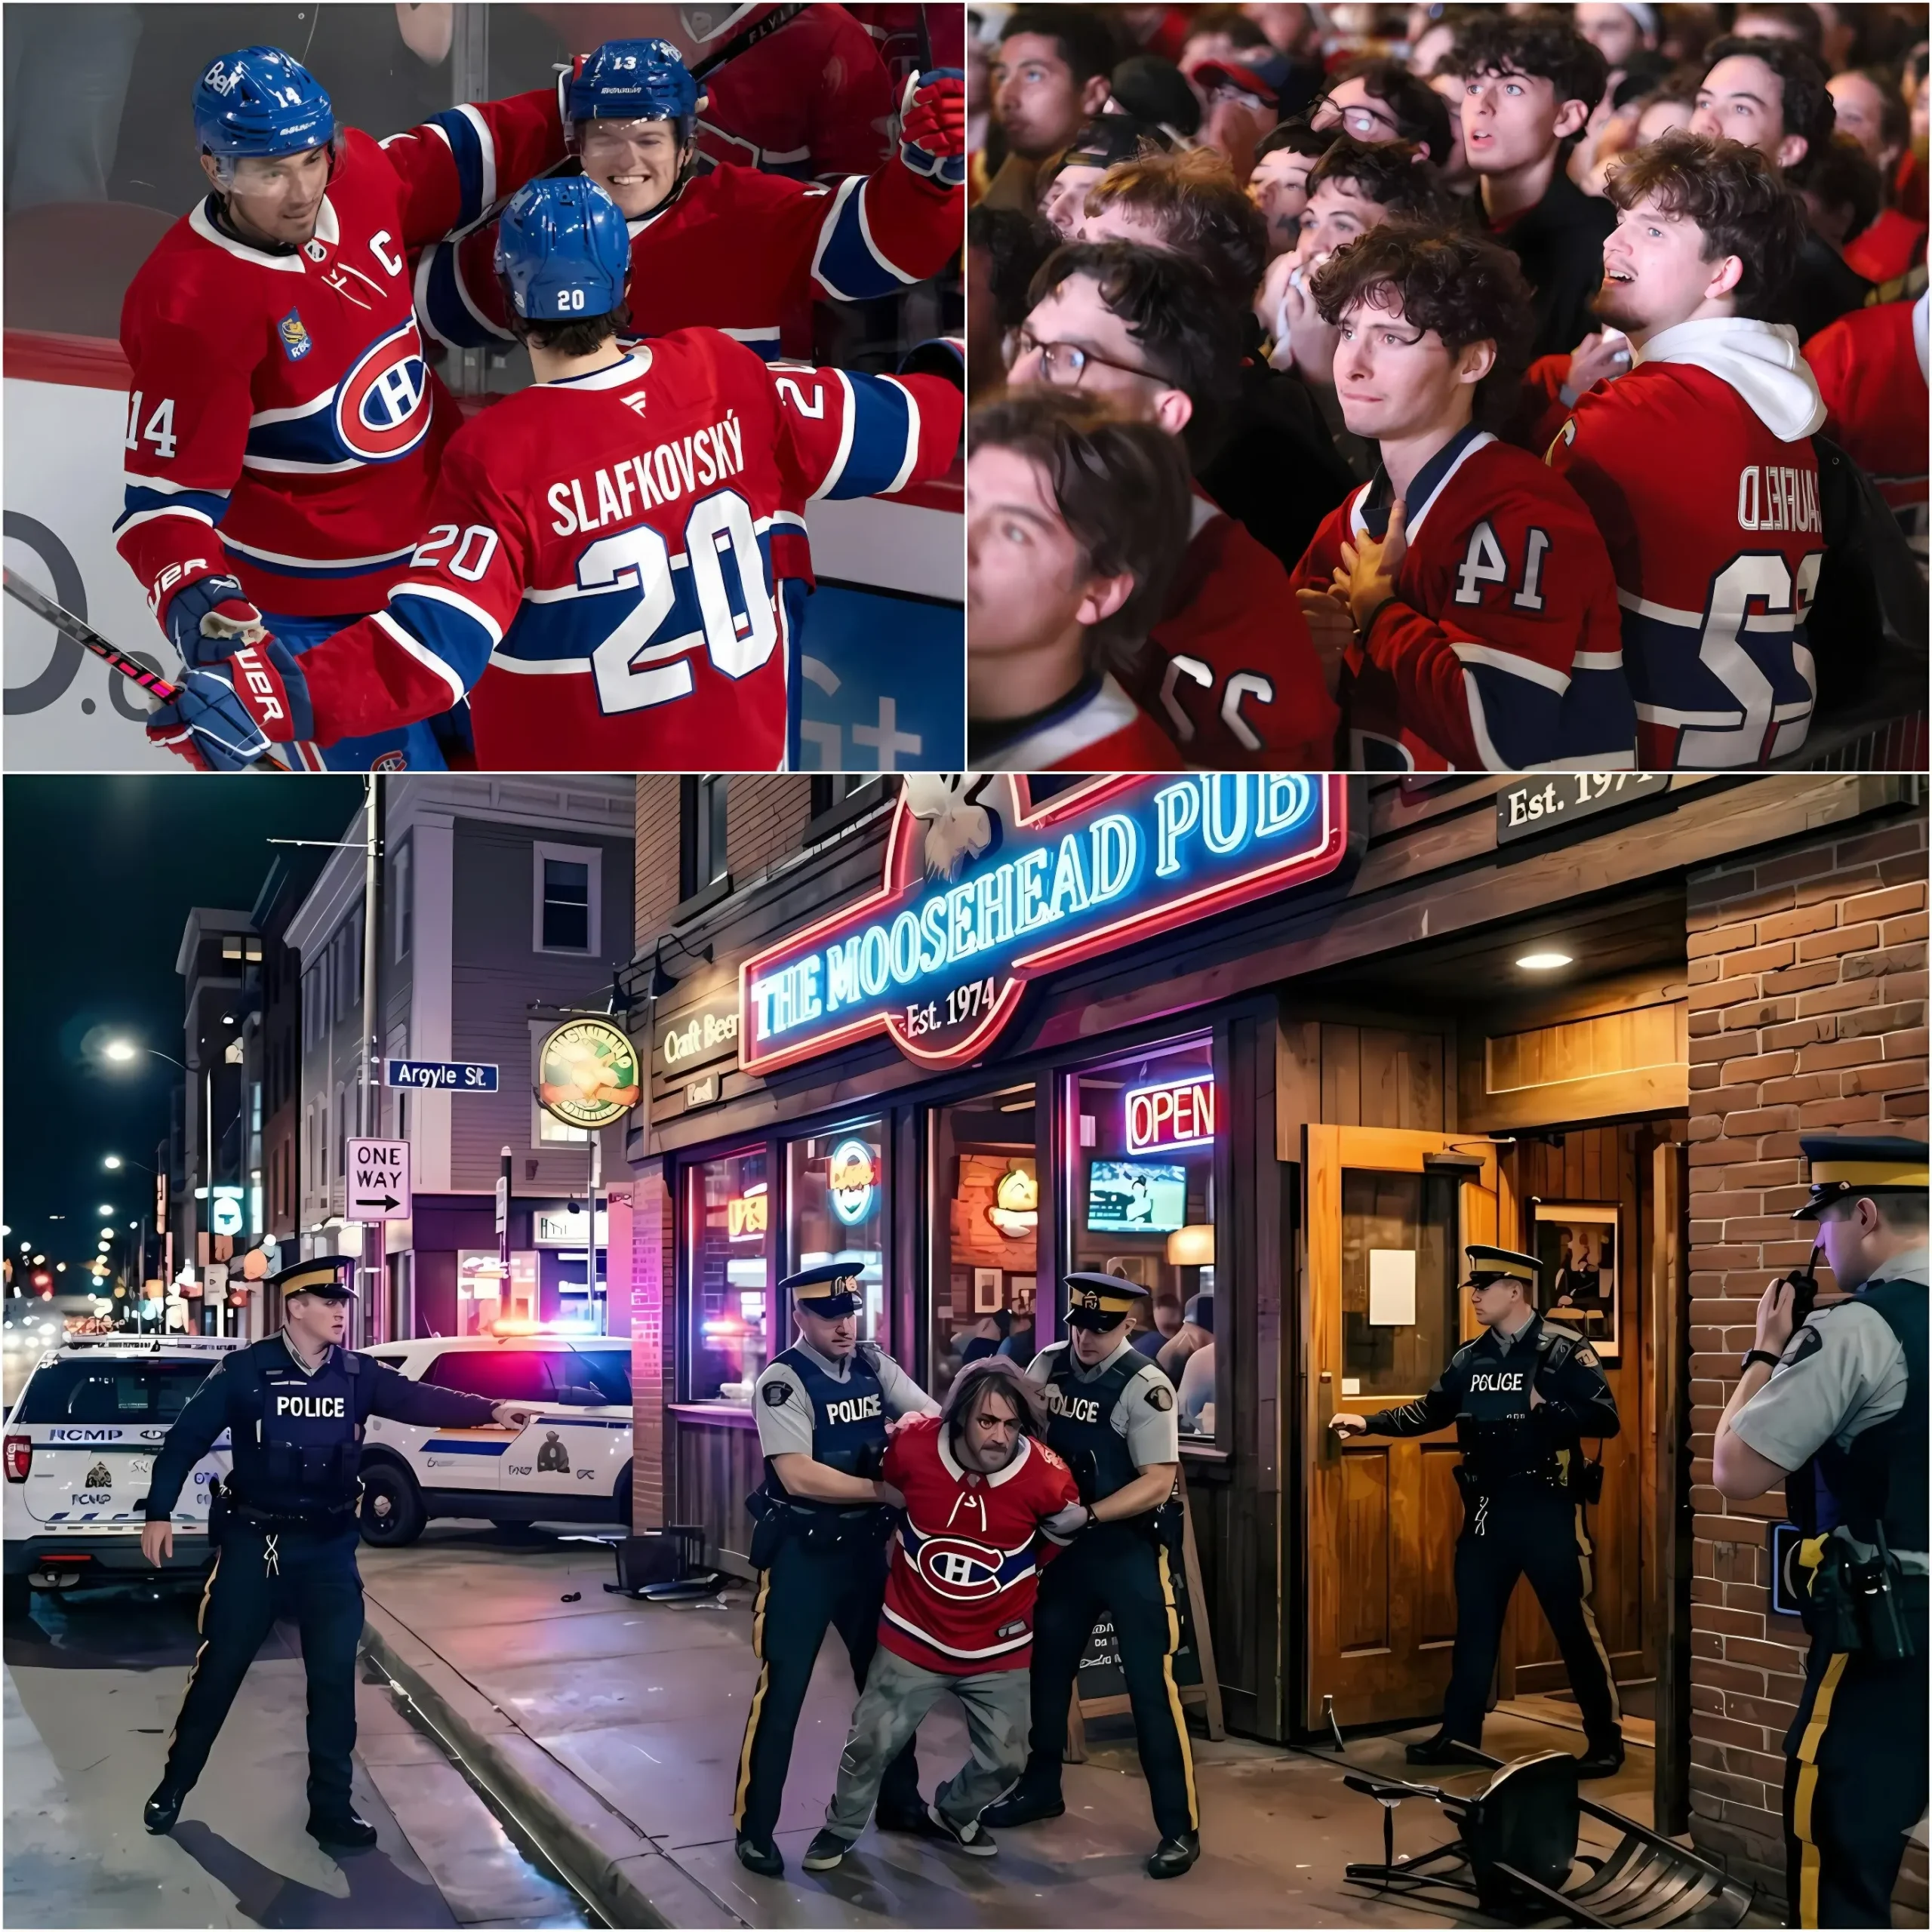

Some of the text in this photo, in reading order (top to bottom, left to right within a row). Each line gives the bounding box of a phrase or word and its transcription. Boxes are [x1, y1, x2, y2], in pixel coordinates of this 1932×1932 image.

[613, 56, 637, 70] 13
[369, 229, 402, 276] C
[557, 289, 585, 311] 20
[125, 389, 177, 458] 14
[546, 409, 744, 537] SLAFKOVSKÝ
[410, 524, 499, 582] 20
[577, 490, 779, 714] 20
[1507, 782, 1564, 827] Est.
[749, 774, 1311, 1041] THE MOOSEHEAD PUB
[945, 976, 995, 1026] 1974
[398, 1063, 457, 1088] Argyle
[1131, 1081, 1215, 1146] OPEN
[356, 1170, 402, 1189] WAY
[357, 1146, 401, 1166] ONE
[276, 1396, 345, 1418] POLICE
